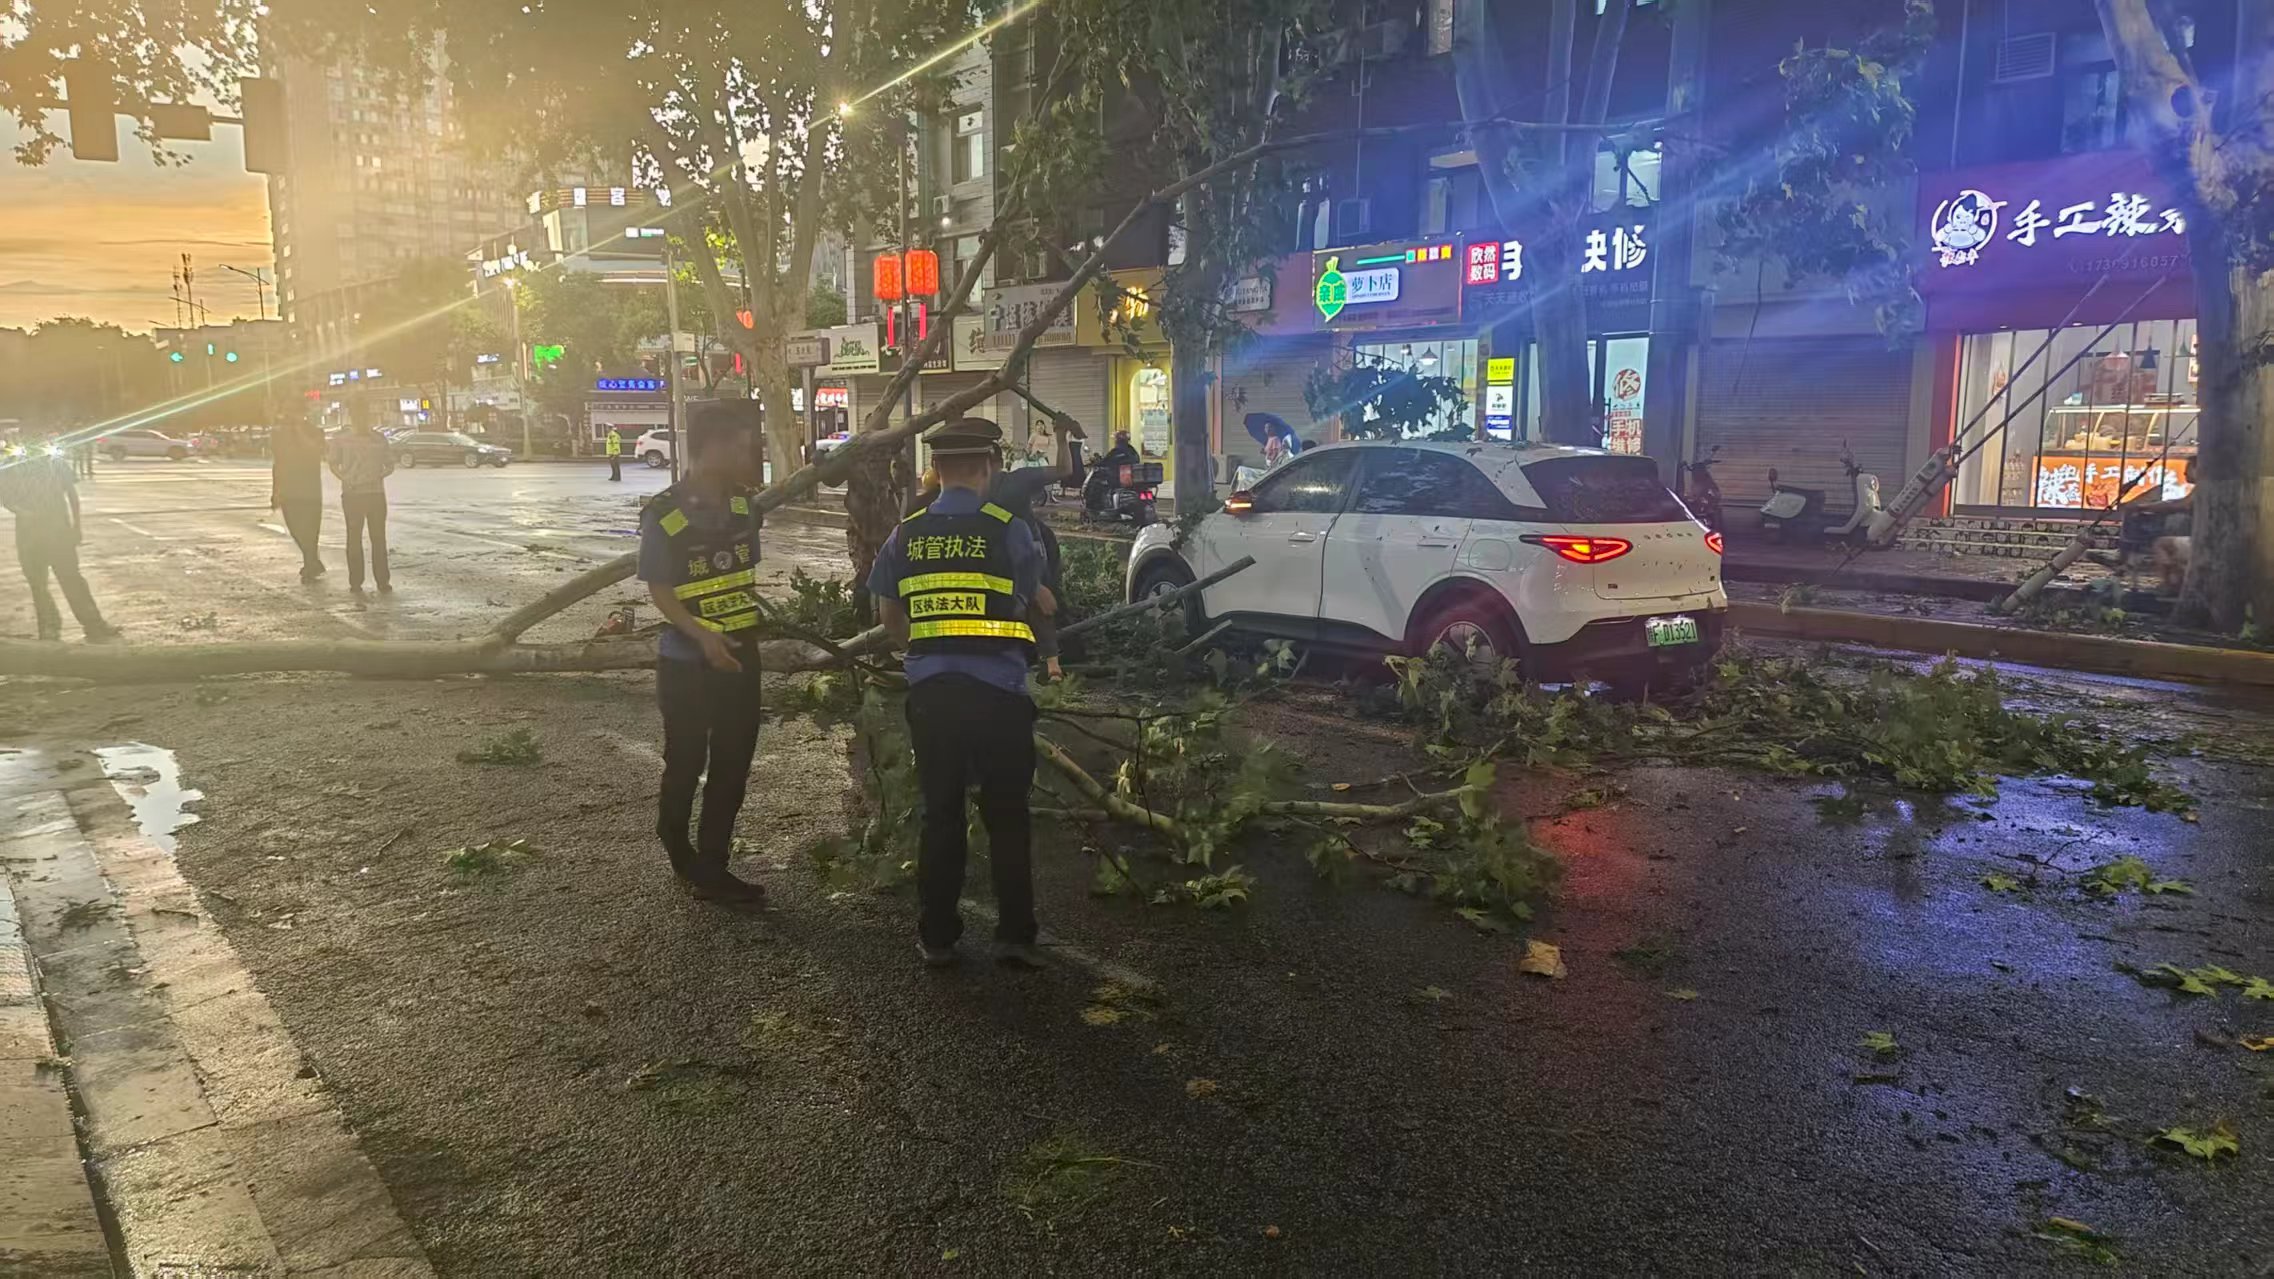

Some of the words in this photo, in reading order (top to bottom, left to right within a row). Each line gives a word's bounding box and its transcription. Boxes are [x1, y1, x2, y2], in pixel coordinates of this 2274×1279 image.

[1351, 273, 1393, 291] 萝卜店
[1610, 419, 1641, 437] 手机
[906, 533, 987, 562] 城管执法
[912, 595, 981, 615] 区执法大队
